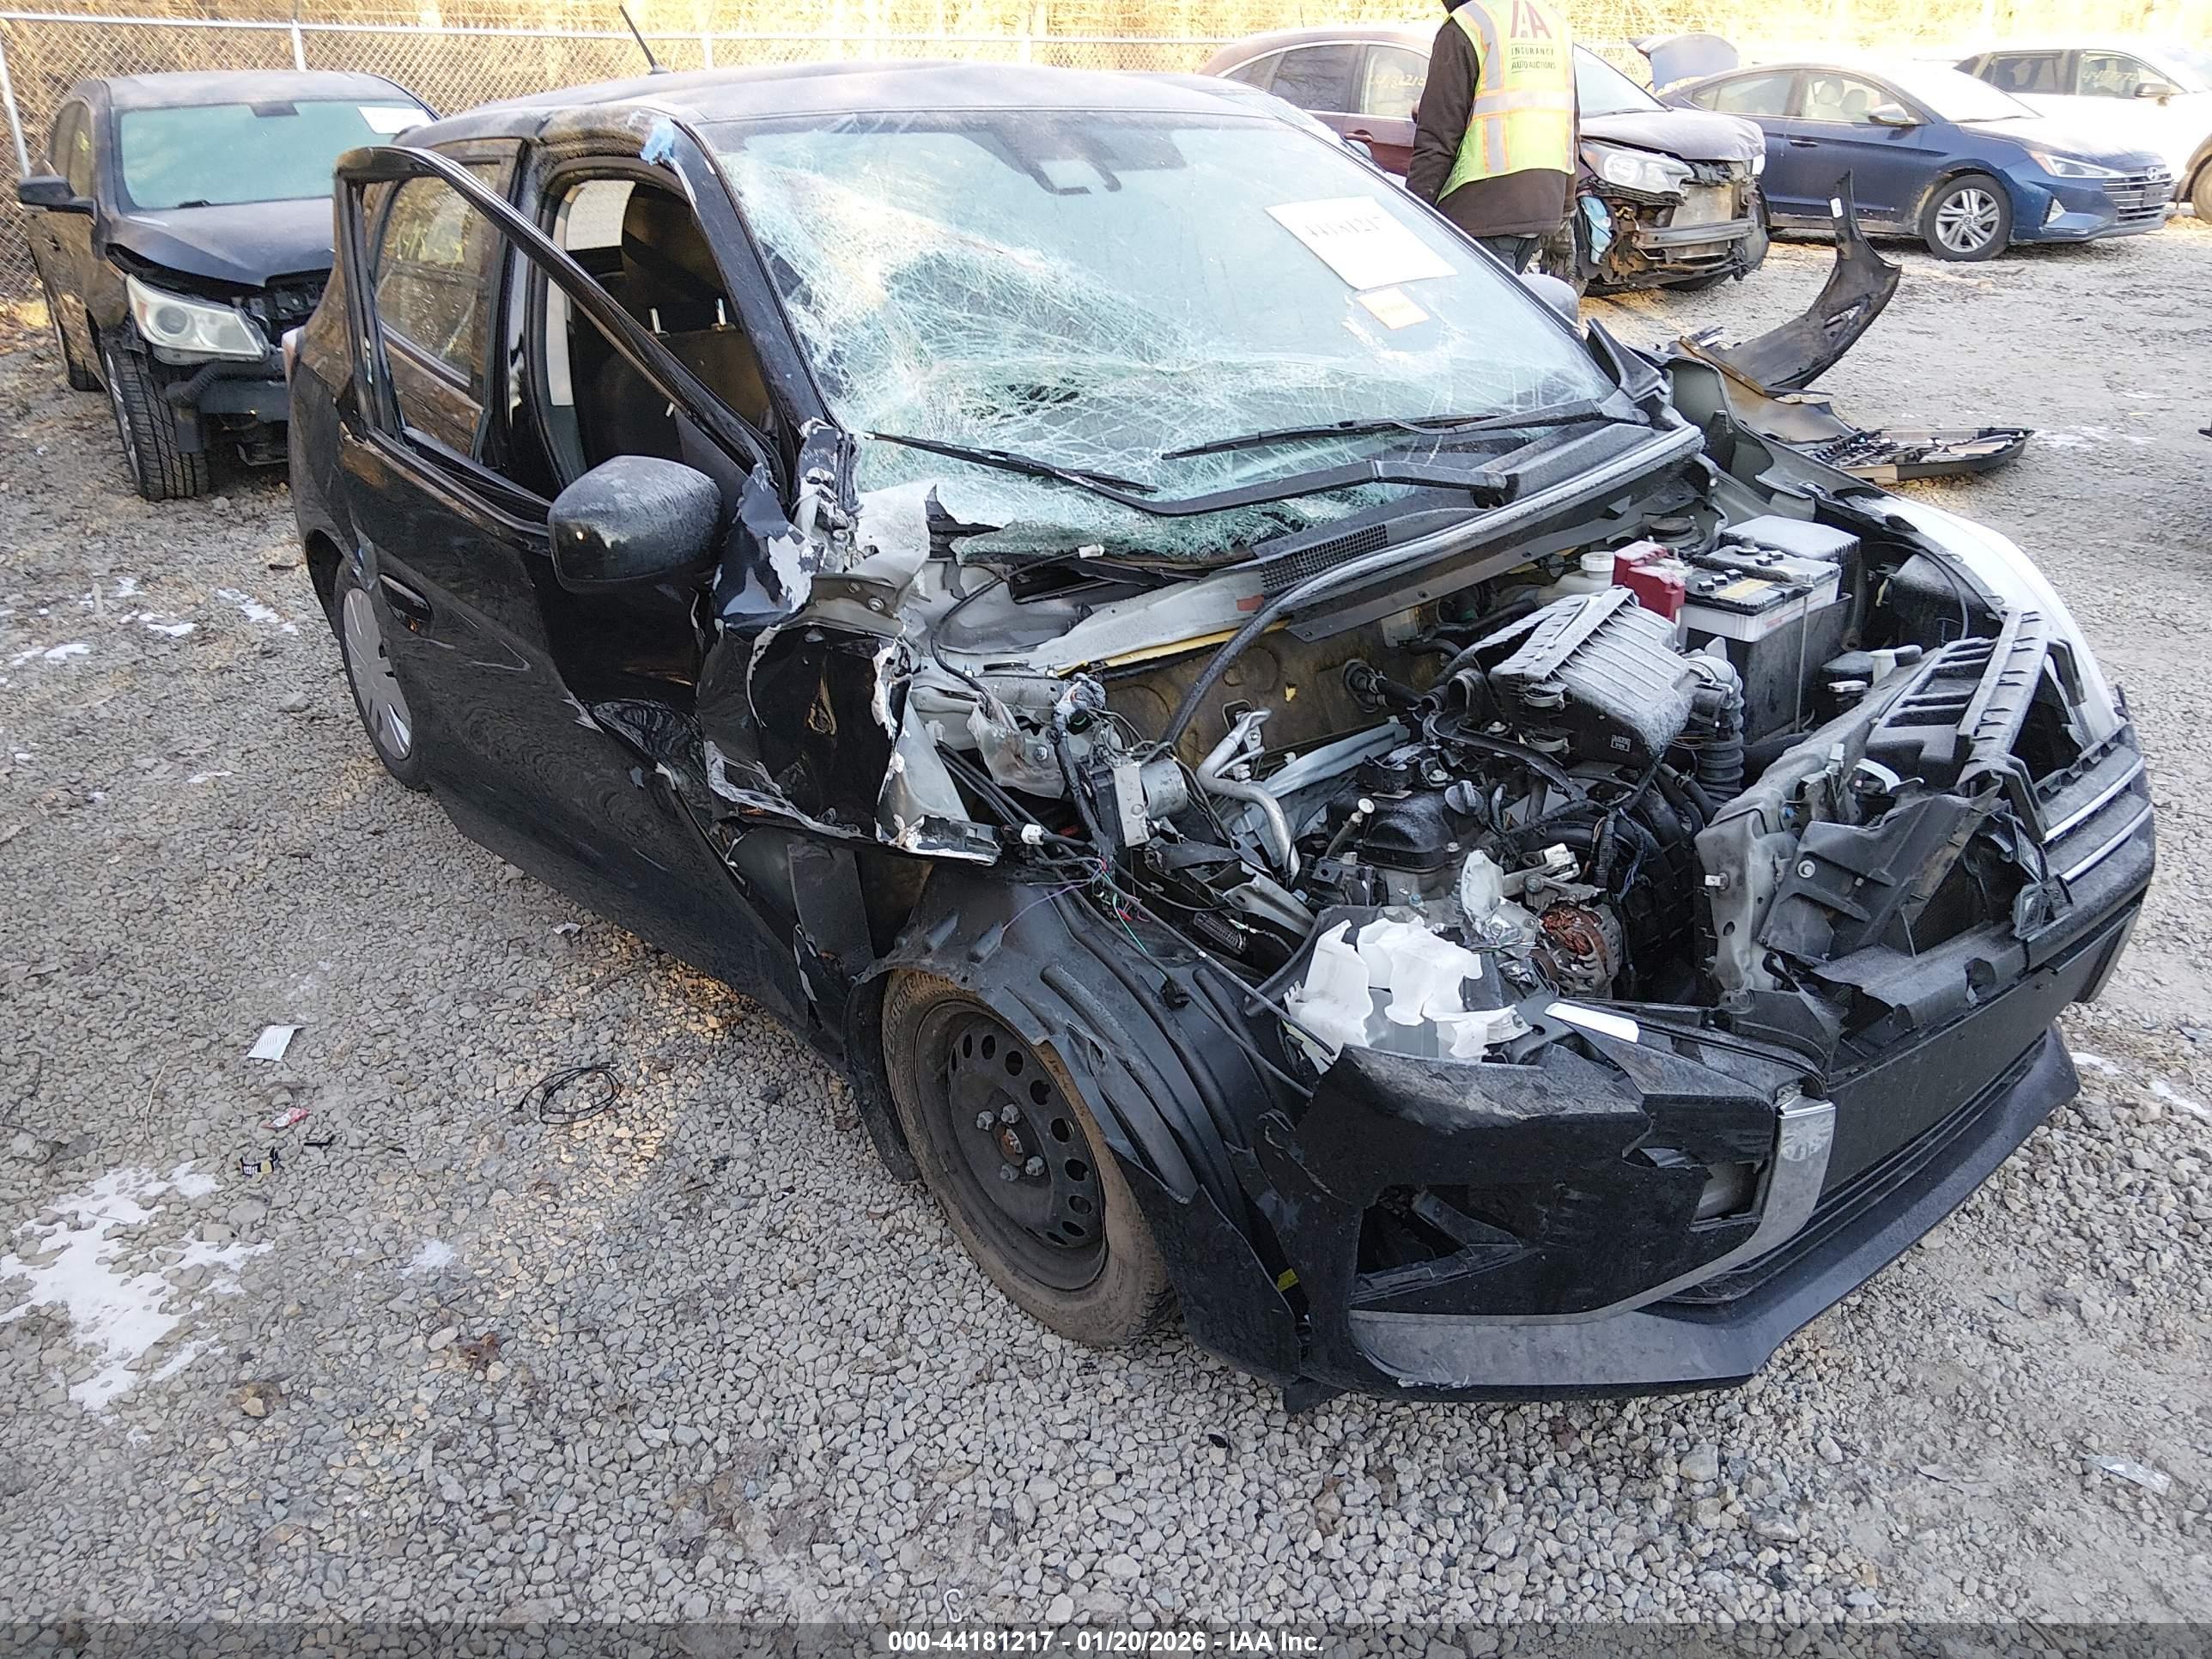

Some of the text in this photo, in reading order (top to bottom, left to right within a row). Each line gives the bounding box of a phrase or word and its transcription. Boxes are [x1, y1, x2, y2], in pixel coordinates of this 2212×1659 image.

[1510, 46, 1553, 56] INSURANCE
[1510, 60, 1556, 70] AUTO AUCTIONS
